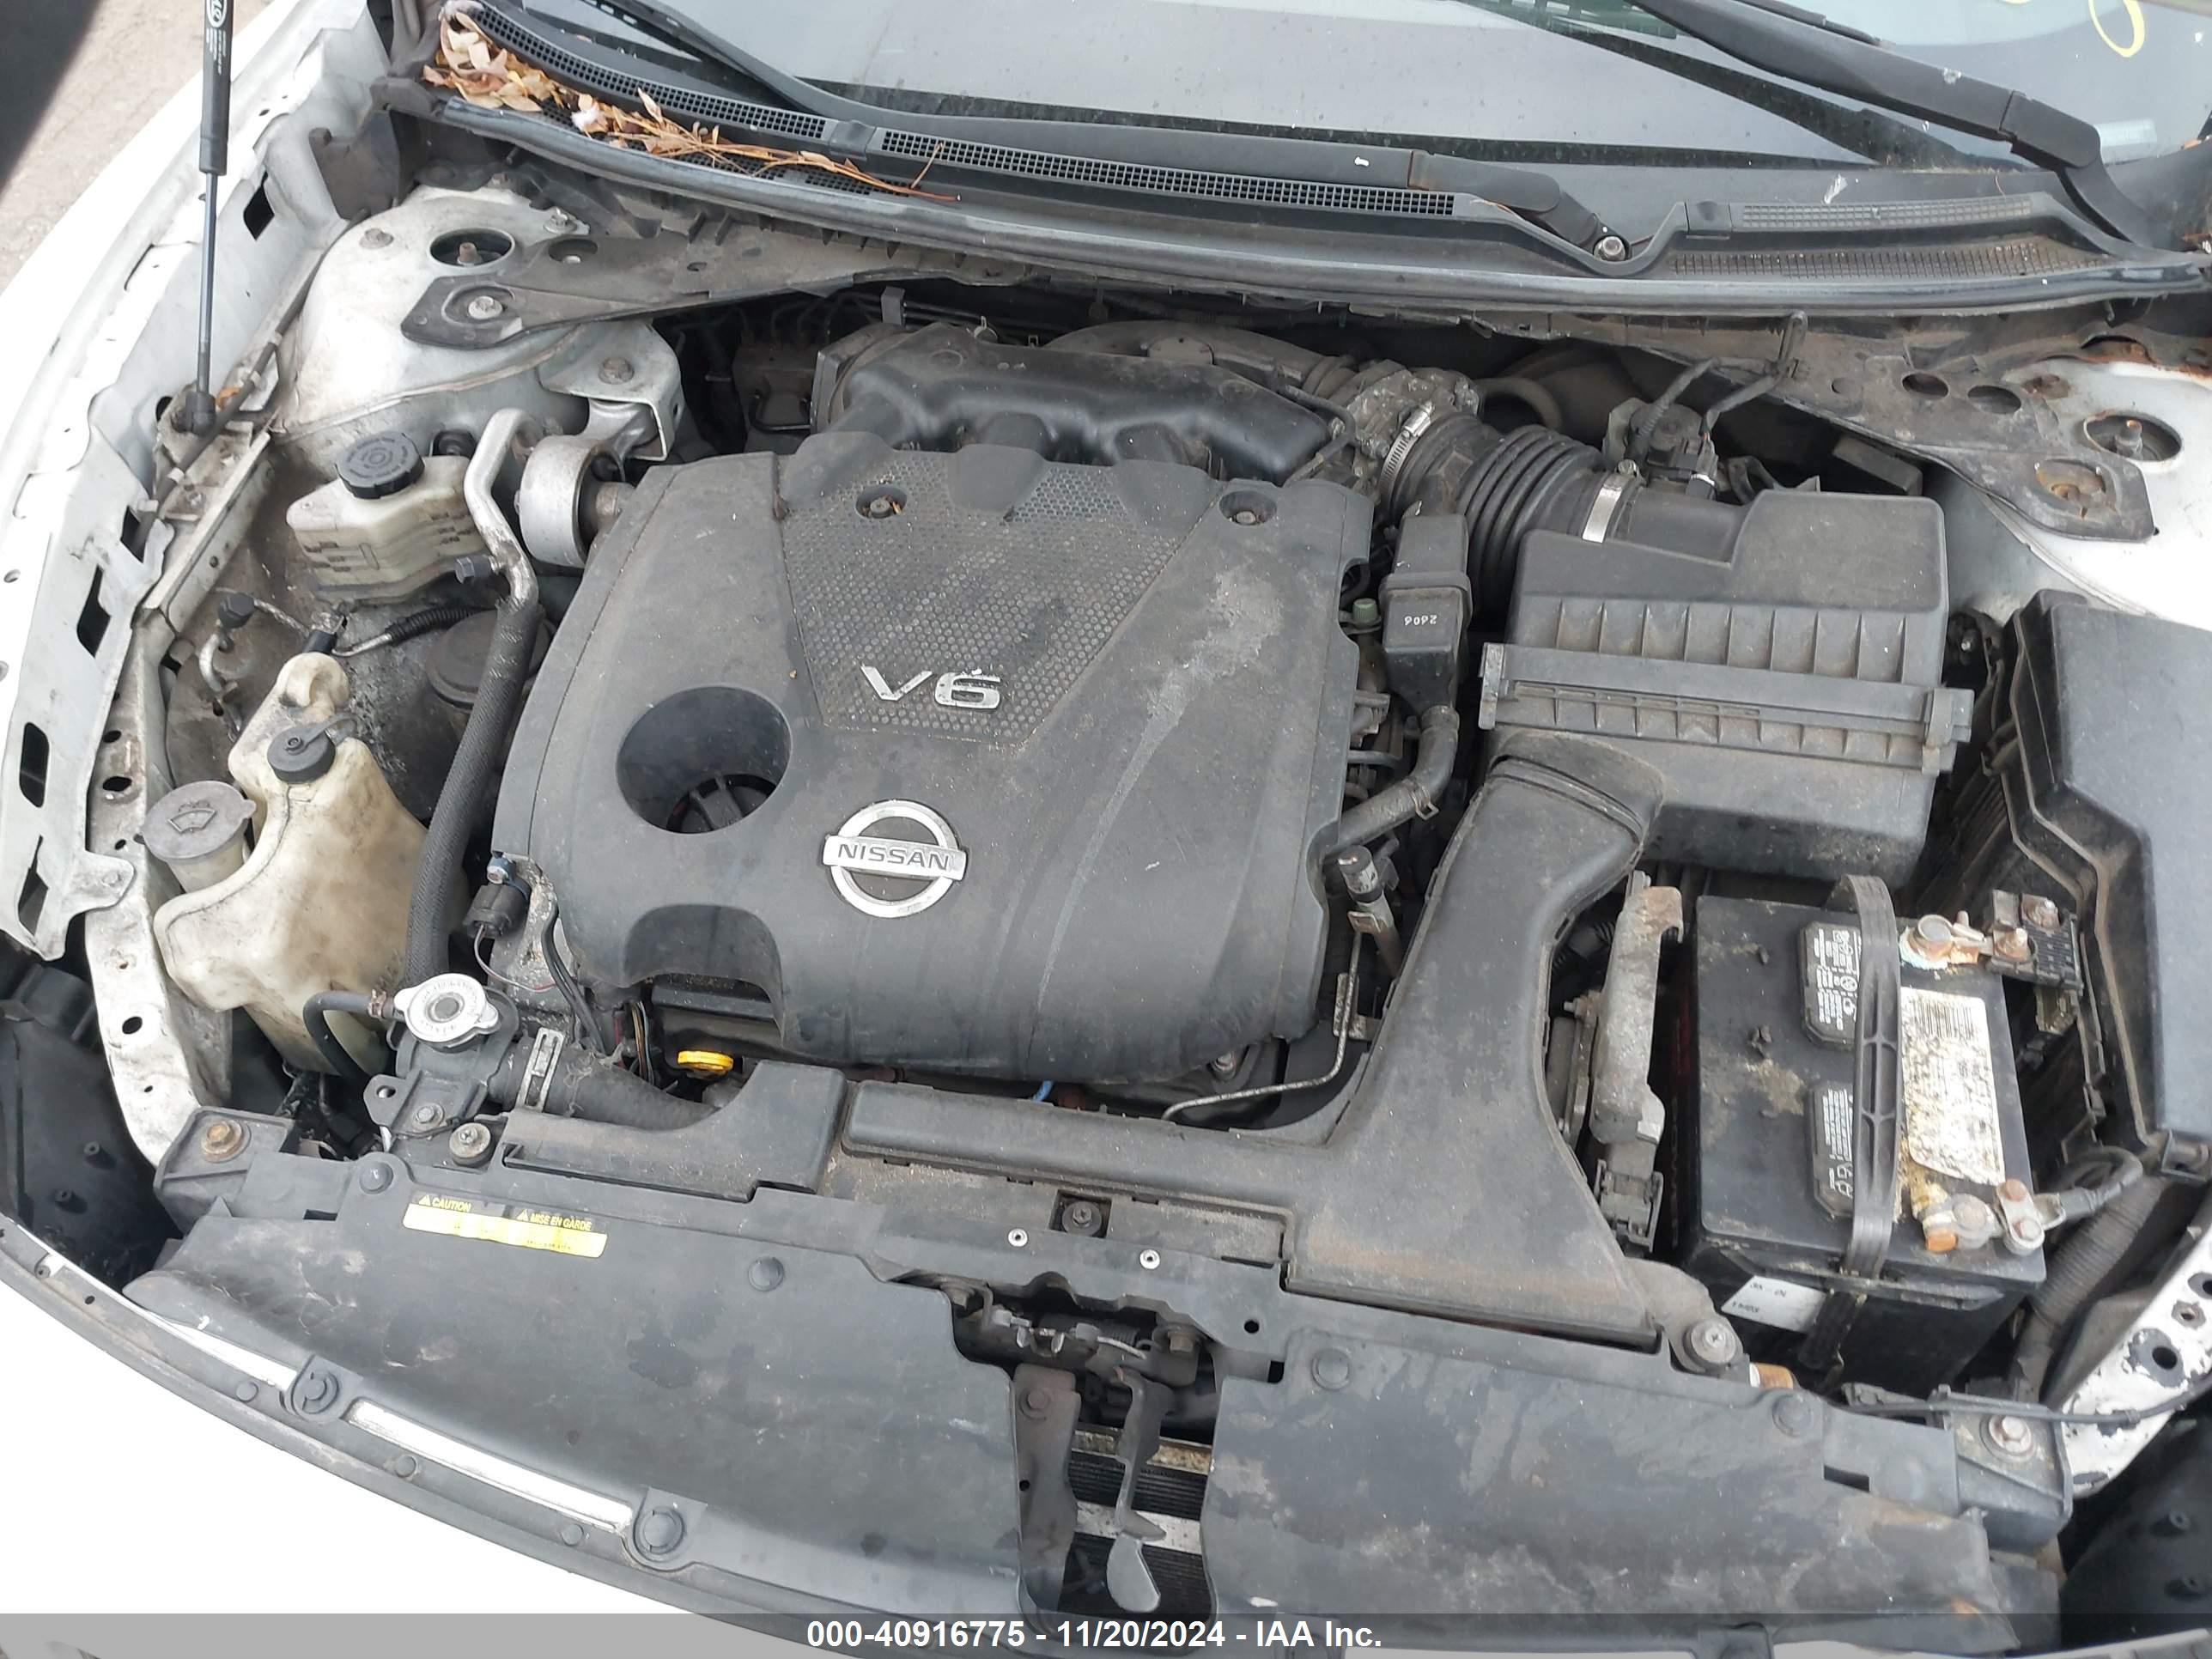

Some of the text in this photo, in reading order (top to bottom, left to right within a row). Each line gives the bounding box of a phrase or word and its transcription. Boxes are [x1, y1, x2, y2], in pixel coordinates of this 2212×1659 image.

[861, 665, 1001, 709] V6
[838, 843, 949, 871] NISSAN
[431, 1196, 471, 1213] CAUTION
[530, 1212, 592, 1232] MISE EN GARDE
